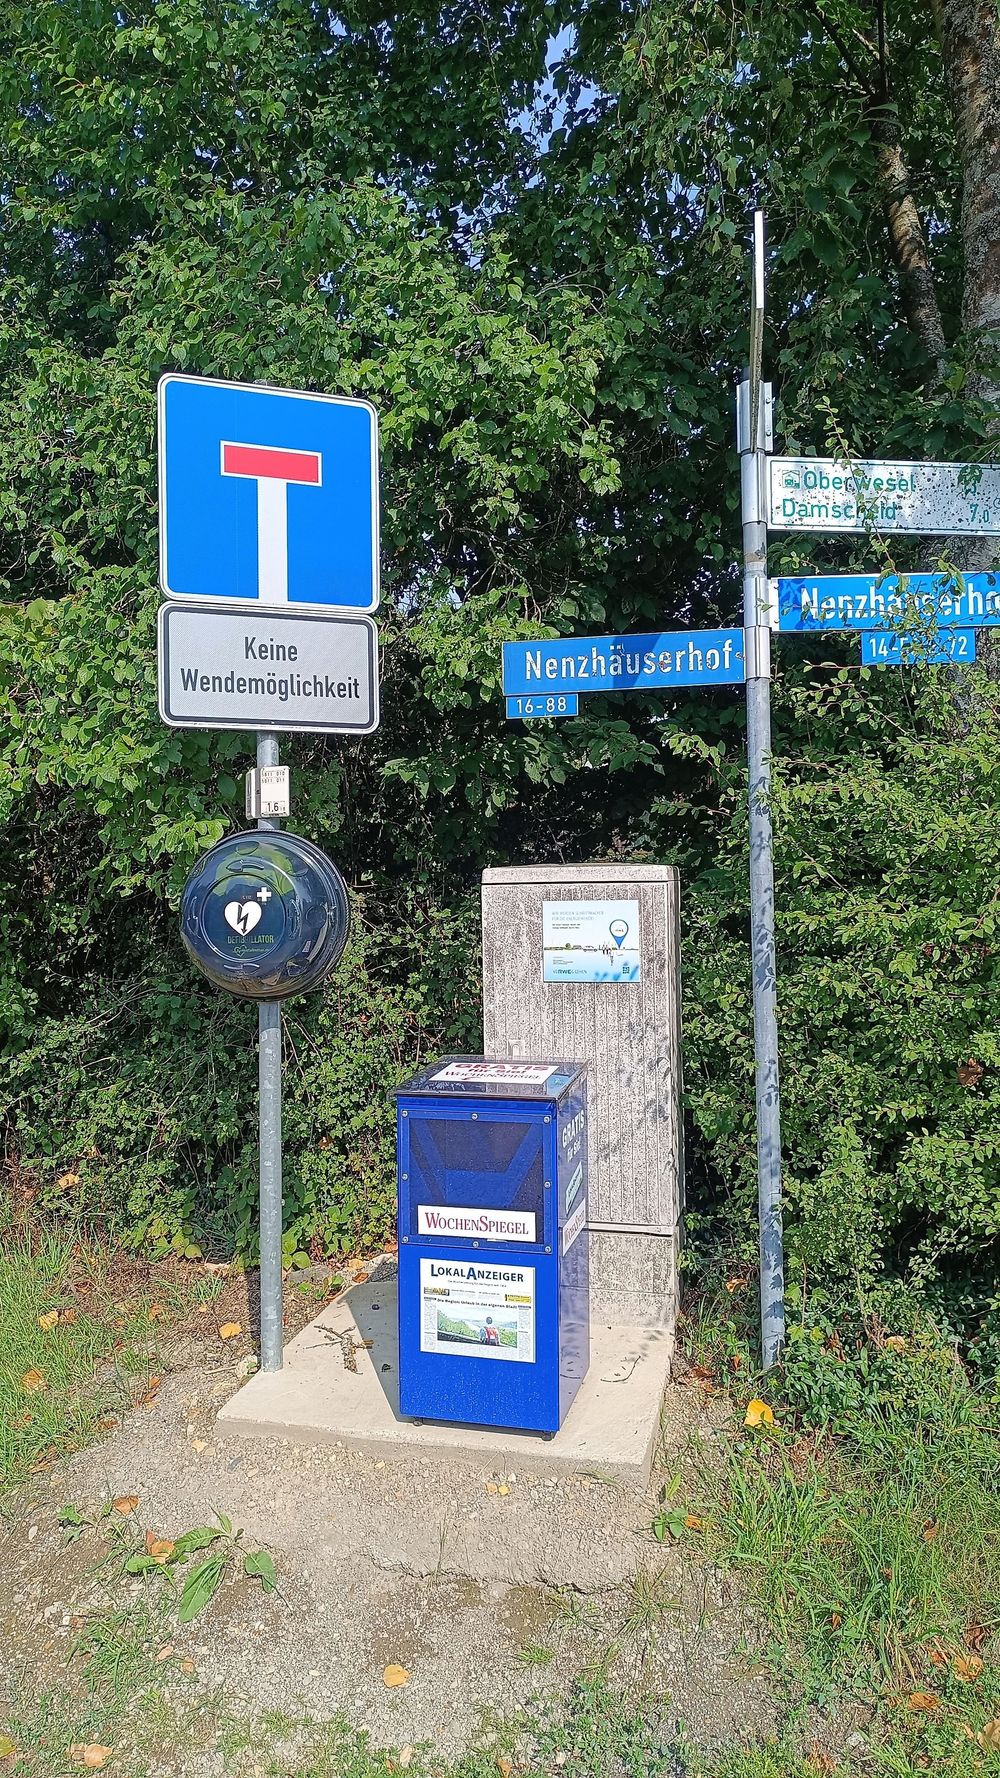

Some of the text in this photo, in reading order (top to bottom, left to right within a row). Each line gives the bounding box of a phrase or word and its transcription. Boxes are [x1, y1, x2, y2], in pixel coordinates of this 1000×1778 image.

[803, 470, 916, 492] Oberwesel
[244, 636, 298, 662] Keine
[525, 639, 733, 680] Nenzhäuserhof
[180, 667, 360, 702] Wendemöglichkeit
[516, 698, 567, 714] 16-88
[454, 1063, 550, 1071] GRATIS
